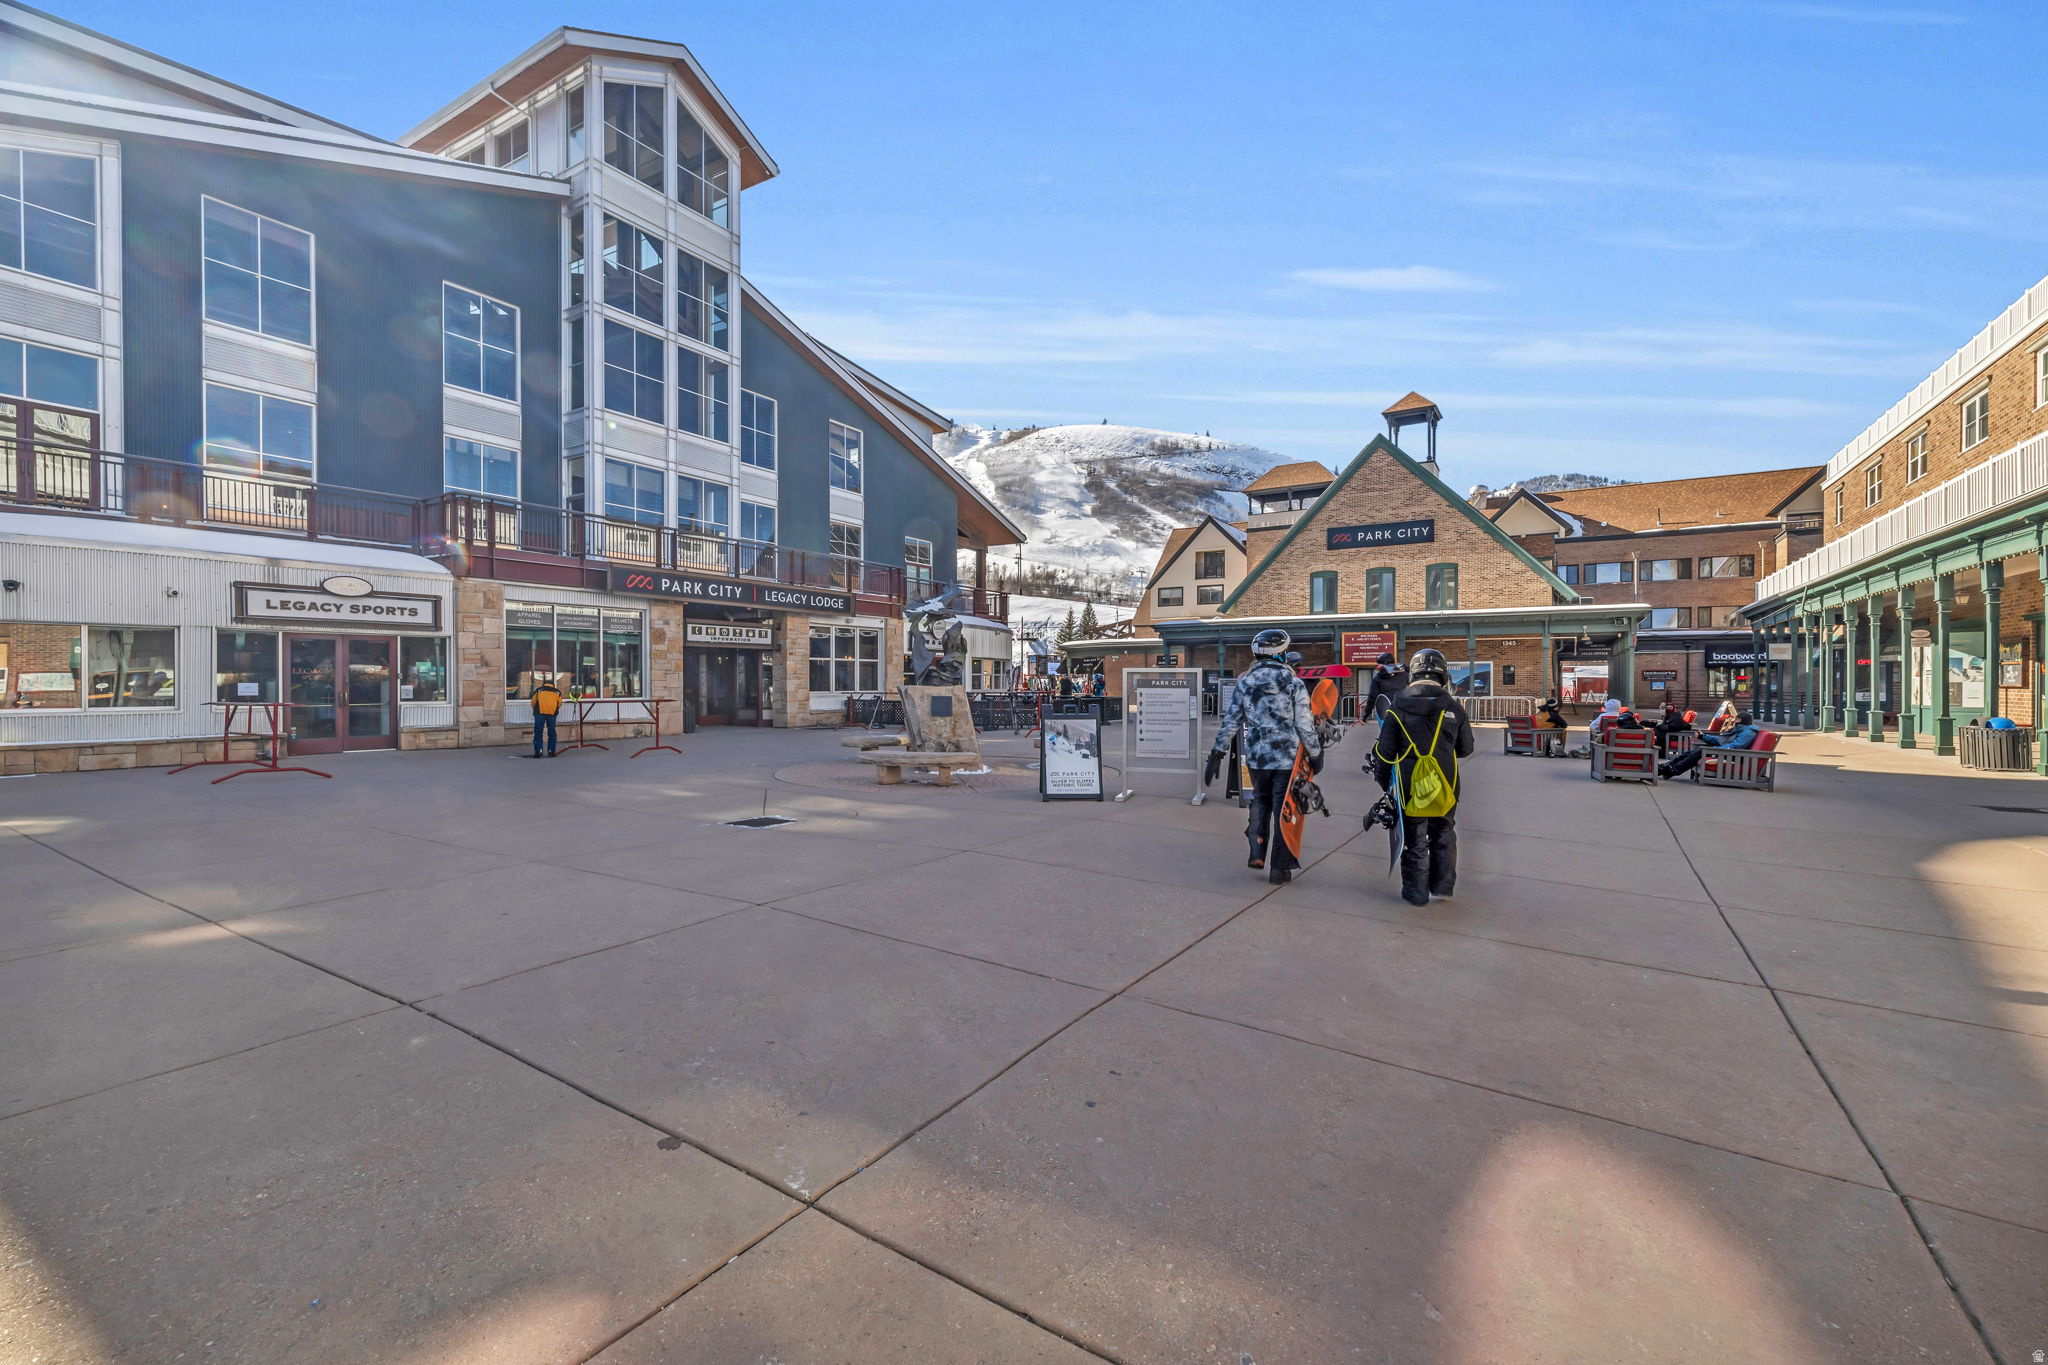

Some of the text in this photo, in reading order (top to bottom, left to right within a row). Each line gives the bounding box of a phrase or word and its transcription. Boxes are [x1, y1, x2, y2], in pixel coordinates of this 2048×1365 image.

[1358, 527, 1430, 541] PARK CITY
[661, 578, 742, 599] PARK CITY
[265, 599, 419, 617] LEGACY SPORTS
[765, 590, 844, 609] LEGACY LODGE
[1414, 769, 1440, 798] NIKE
